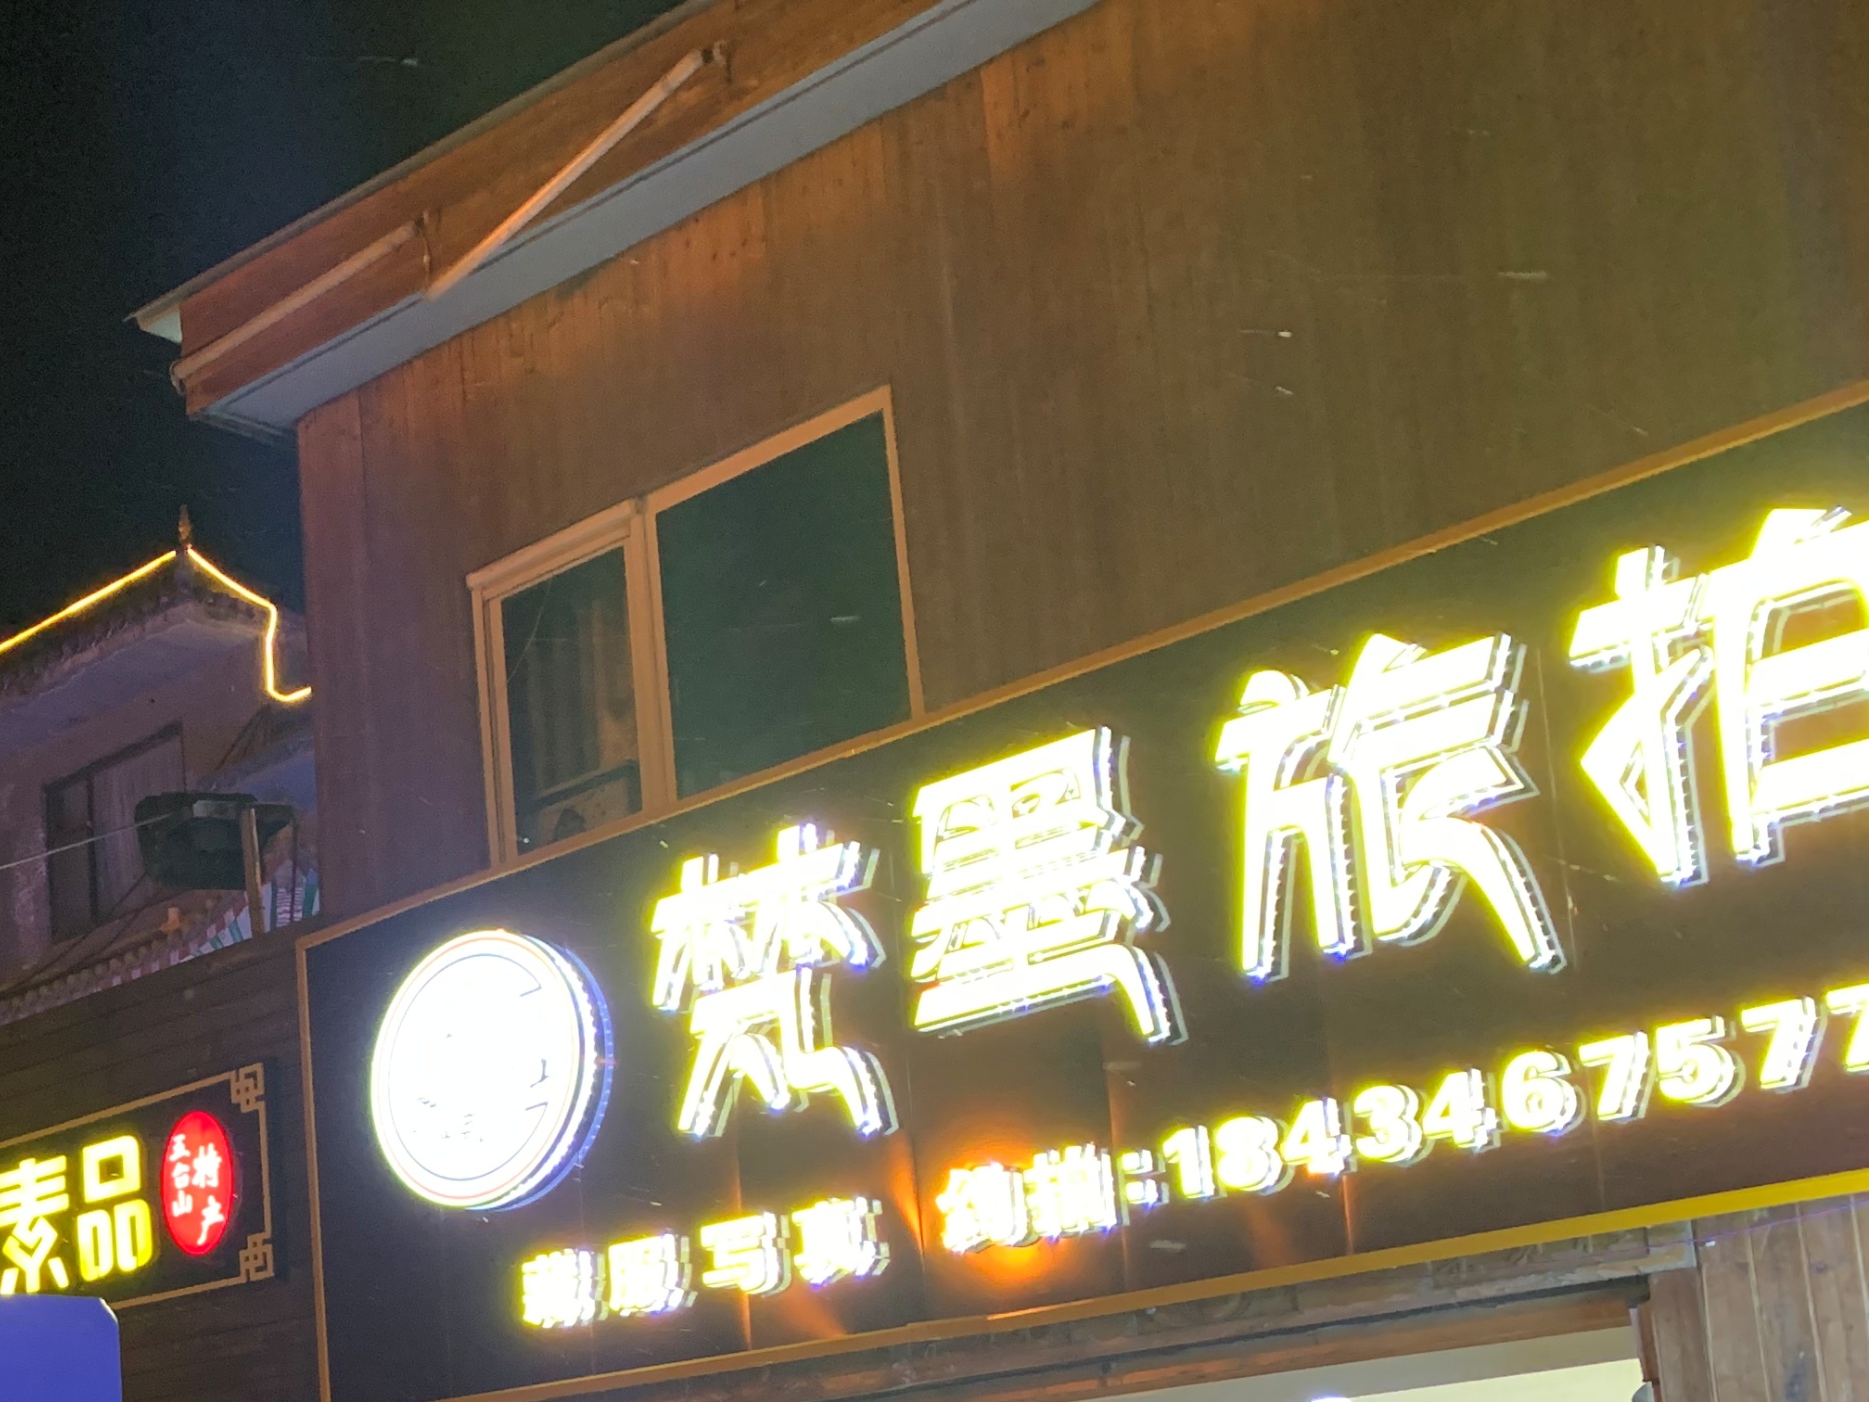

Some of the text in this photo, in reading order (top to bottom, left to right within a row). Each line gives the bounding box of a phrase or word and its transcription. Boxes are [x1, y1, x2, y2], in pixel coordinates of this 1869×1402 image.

[650, 505, 1869, 1140] 梵墨旅拍
[168, 1133, 193, 1219] 五台山
[192, 1143, 226, 1247] 特产
